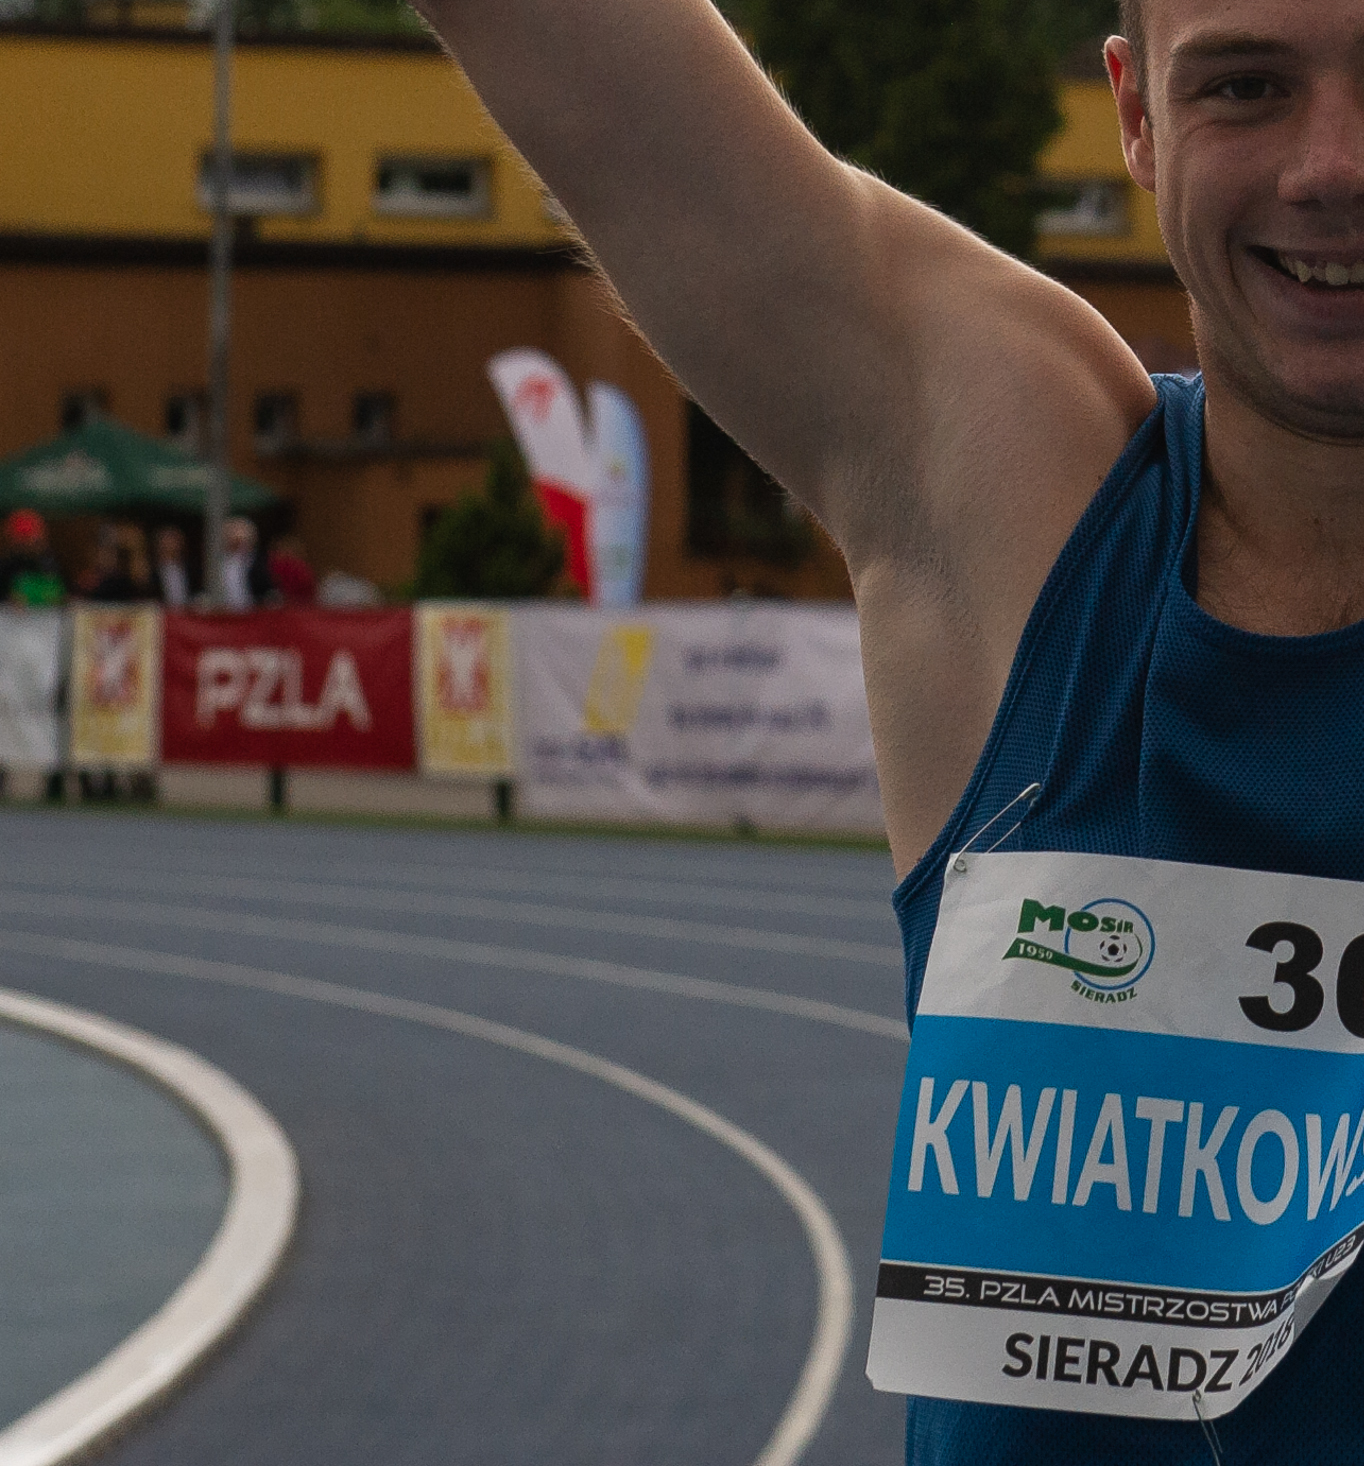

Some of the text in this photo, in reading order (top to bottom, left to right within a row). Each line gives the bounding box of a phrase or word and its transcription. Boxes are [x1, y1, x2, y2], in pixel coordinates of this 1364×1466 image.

[197, 647, 373, 731] PZLA
[1070, 980, 1137, 1003] SIERADZ
[923, 1275, 970, 1299] 35.
[979, 1280, 1060, 1308] PZLA
[1068, 1288, 1277, 1322] MISTRZOSTWA
[1325, 1234, 1356, 1269] U23
[1002, 1332, 1240, 1394] SIERADZ
